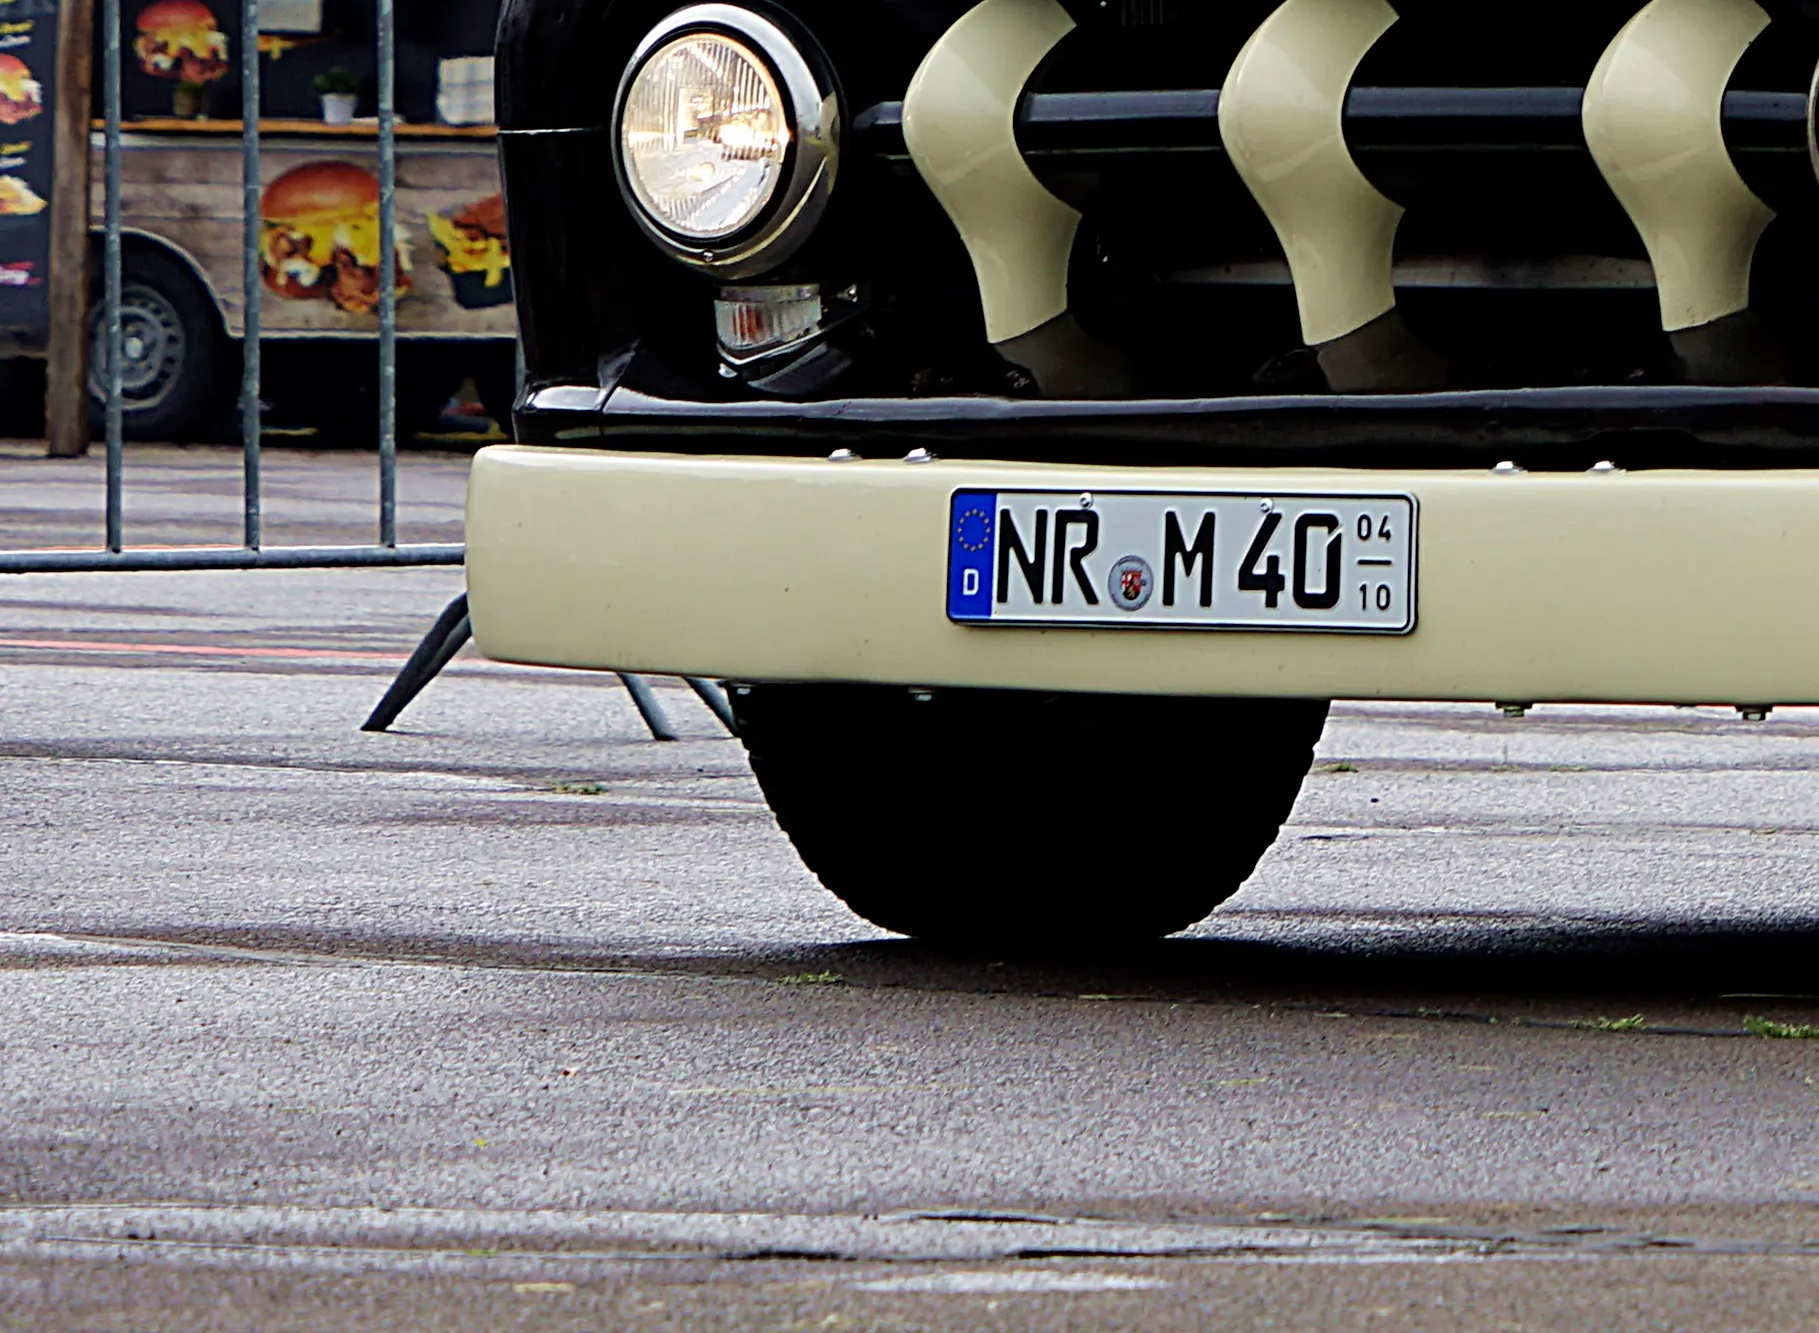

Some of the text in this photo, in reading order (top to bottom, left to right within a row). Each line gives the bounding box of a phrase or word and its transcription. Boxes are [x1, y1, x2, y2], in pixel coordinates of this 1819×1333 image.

[1356, 513, 1392, 543] 04
[997, 507, 1343, 610] NR M 40
[961, 568, 979, 597] D
[1358, 583, 1391, 612] 10
